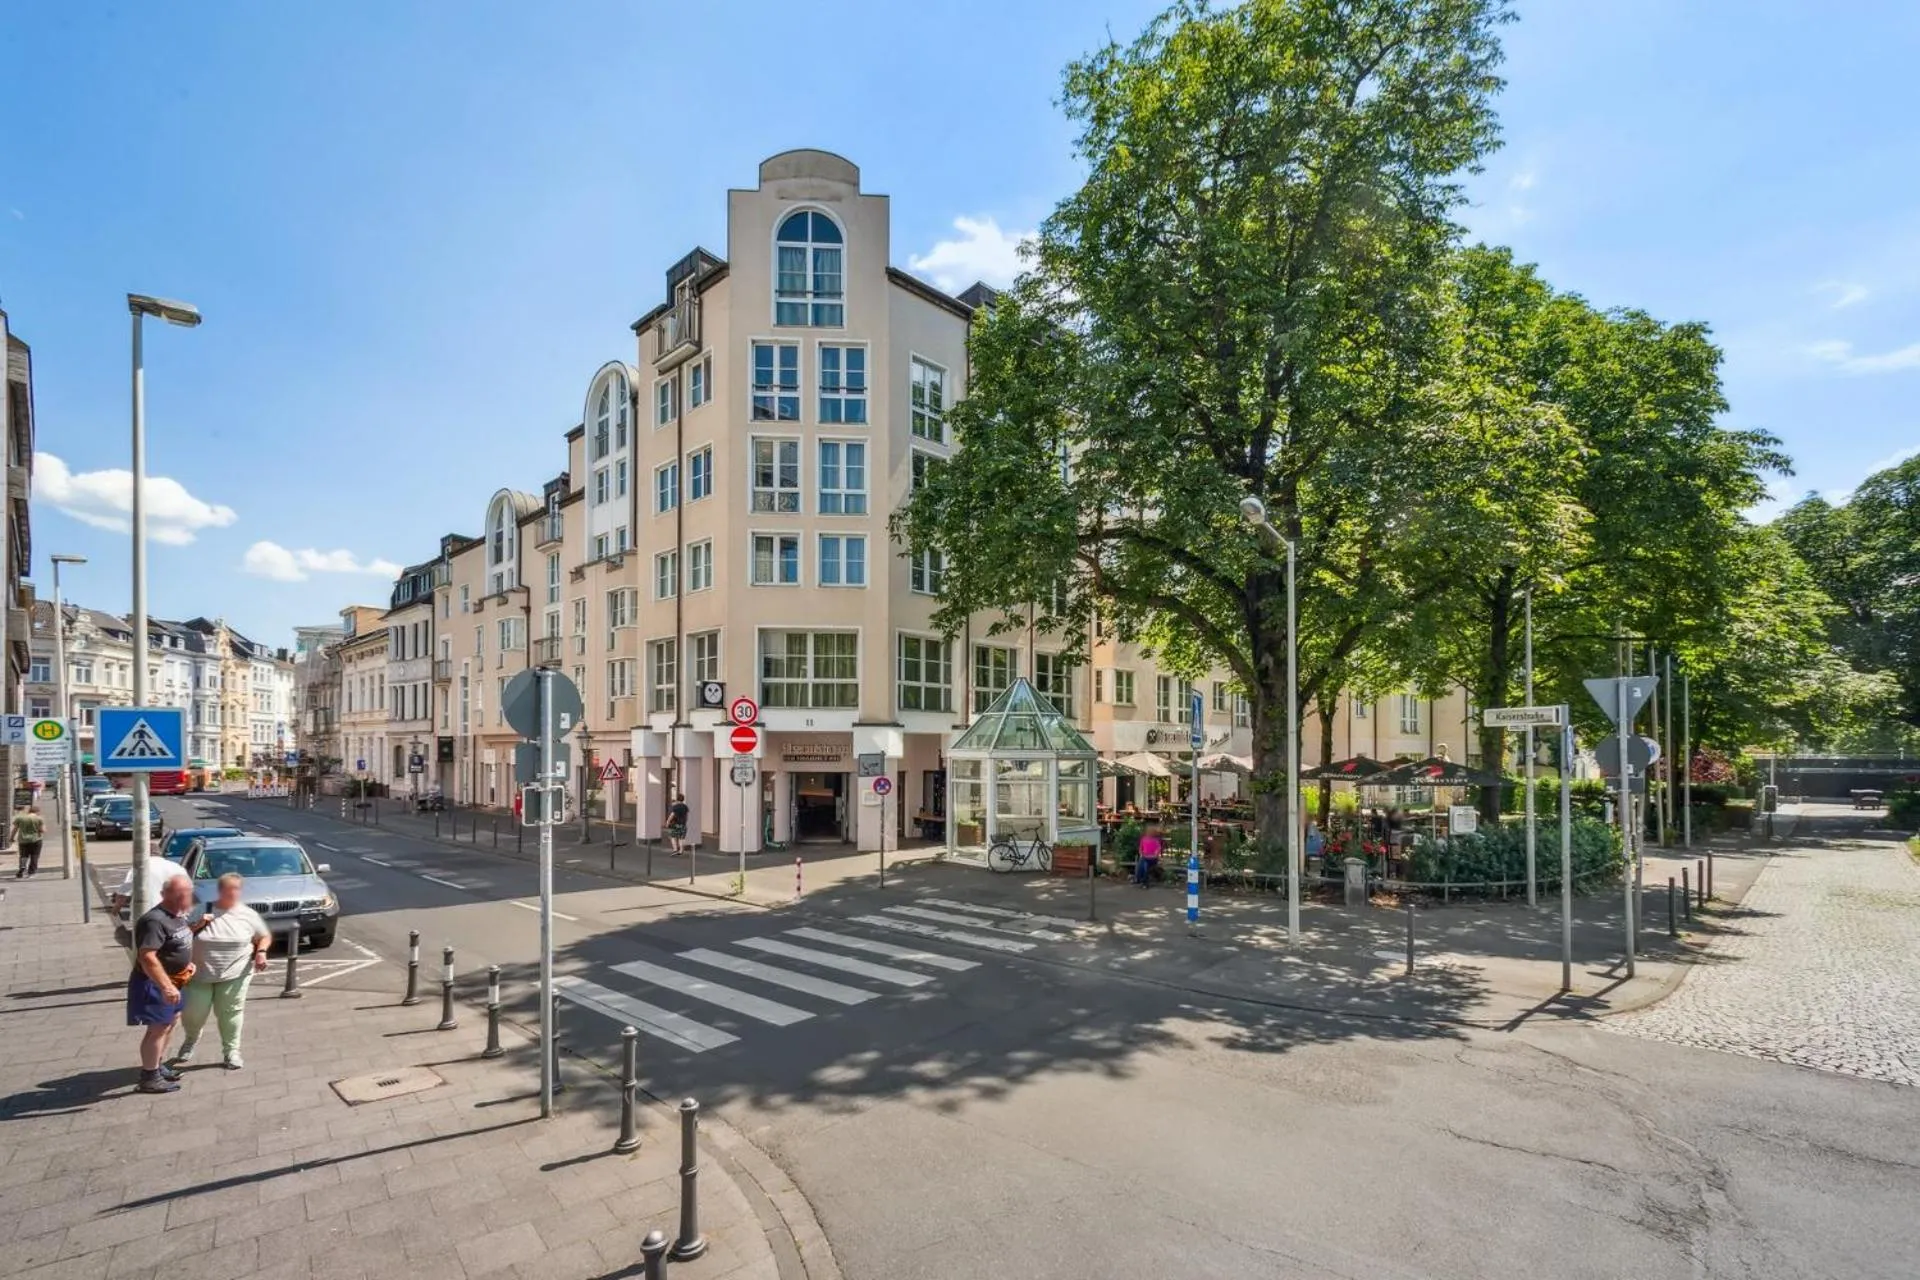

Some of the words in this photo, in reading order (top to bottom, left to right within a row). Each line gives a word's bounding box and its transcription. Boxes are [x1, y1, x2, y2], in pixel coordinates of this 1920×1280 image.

[736, 705, 753, 718] 30
[1495, 711, 1545, 721] Kaiserstraße
[11, 731, 21, 740] P
[42, 725, 55, 737] H
